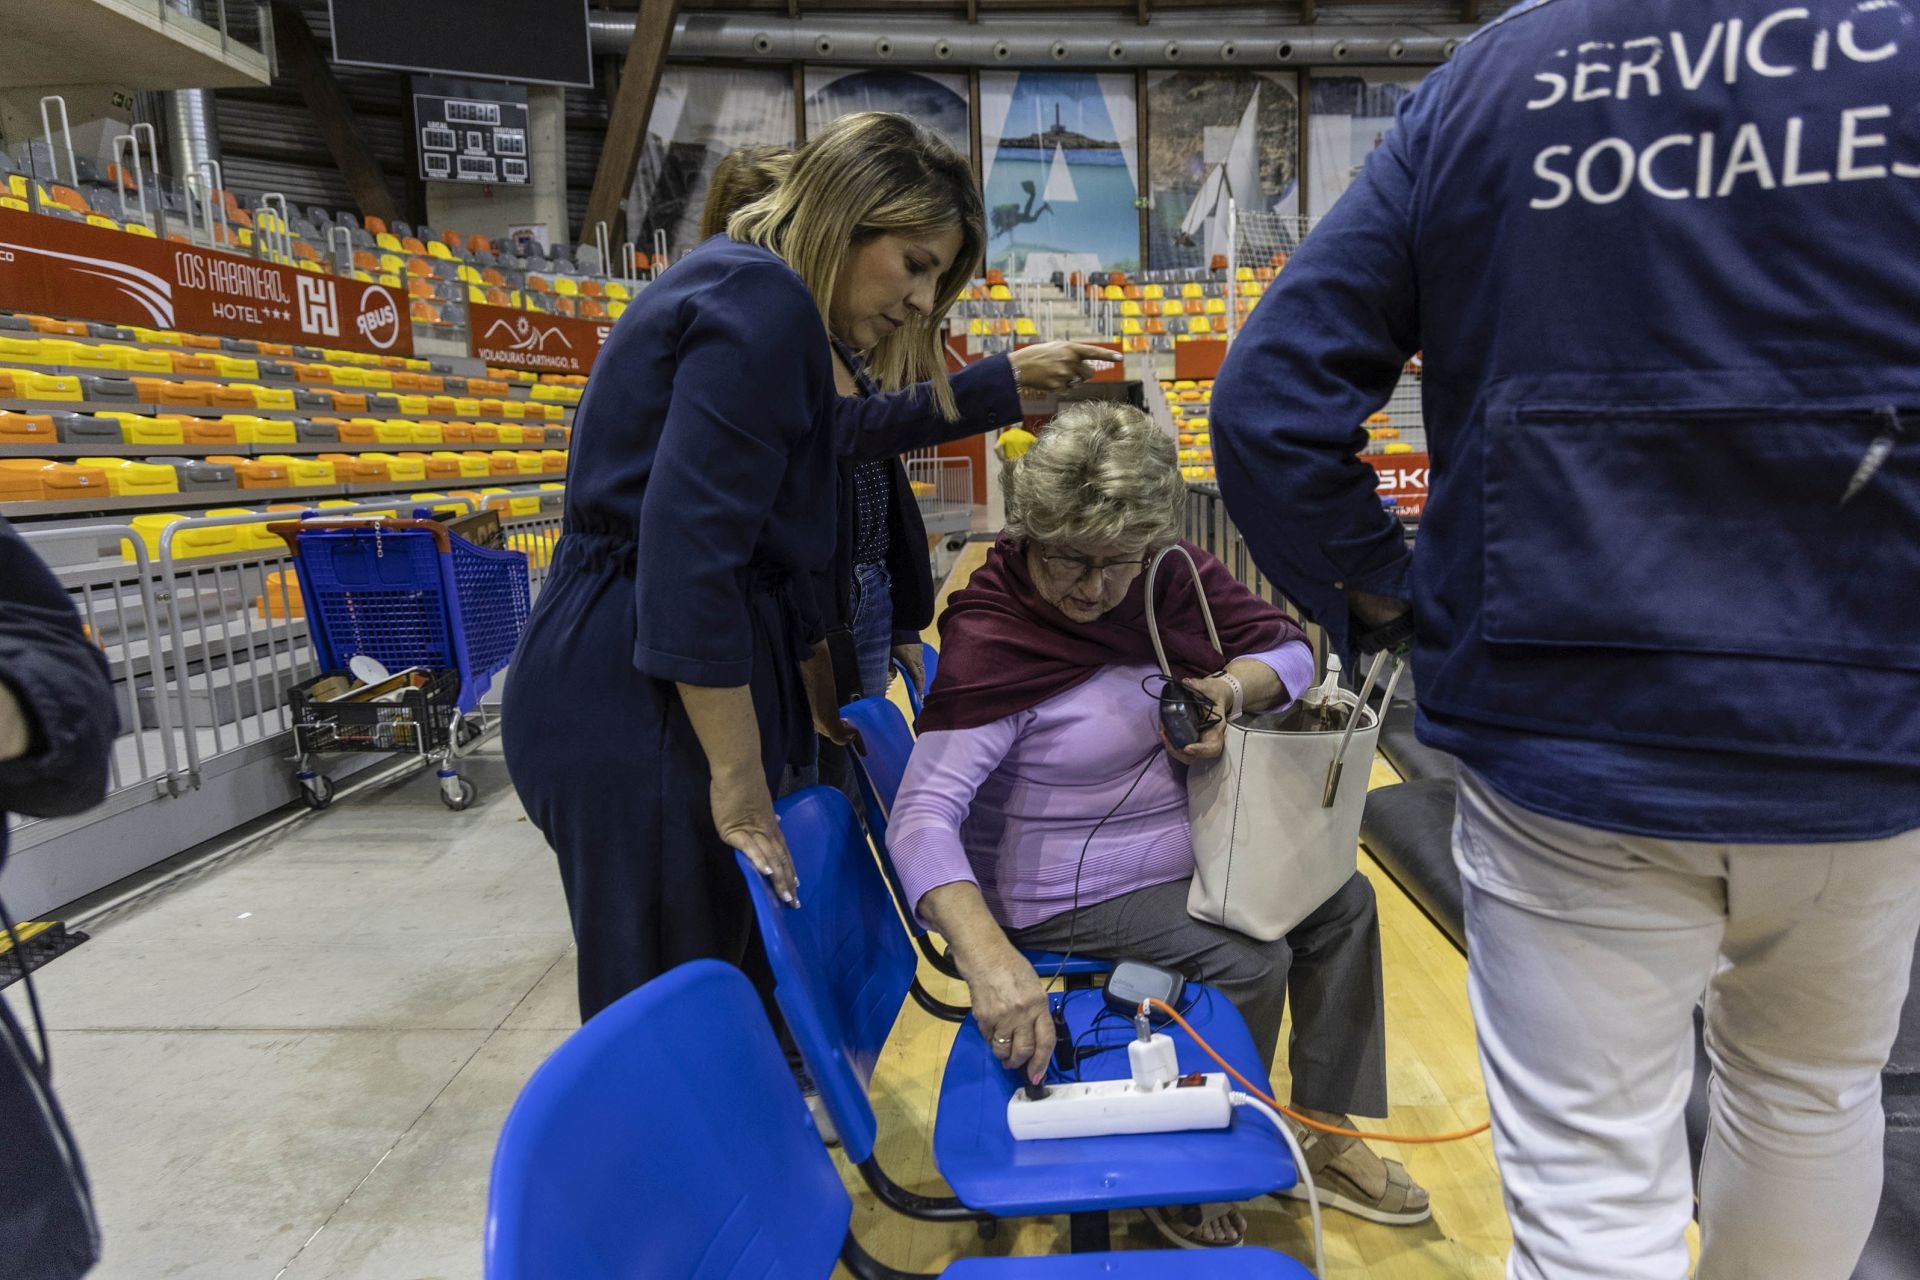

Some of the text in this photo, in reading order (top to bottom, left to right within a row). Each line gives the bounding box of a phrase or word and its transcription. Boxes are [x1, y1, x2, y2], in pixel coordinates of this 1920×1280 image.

[175, 251, 291, 304] LOS HABANERO
[212, 301, 263, 324] HOTEL
[478, 347, 525, 365] VOLADURAS
